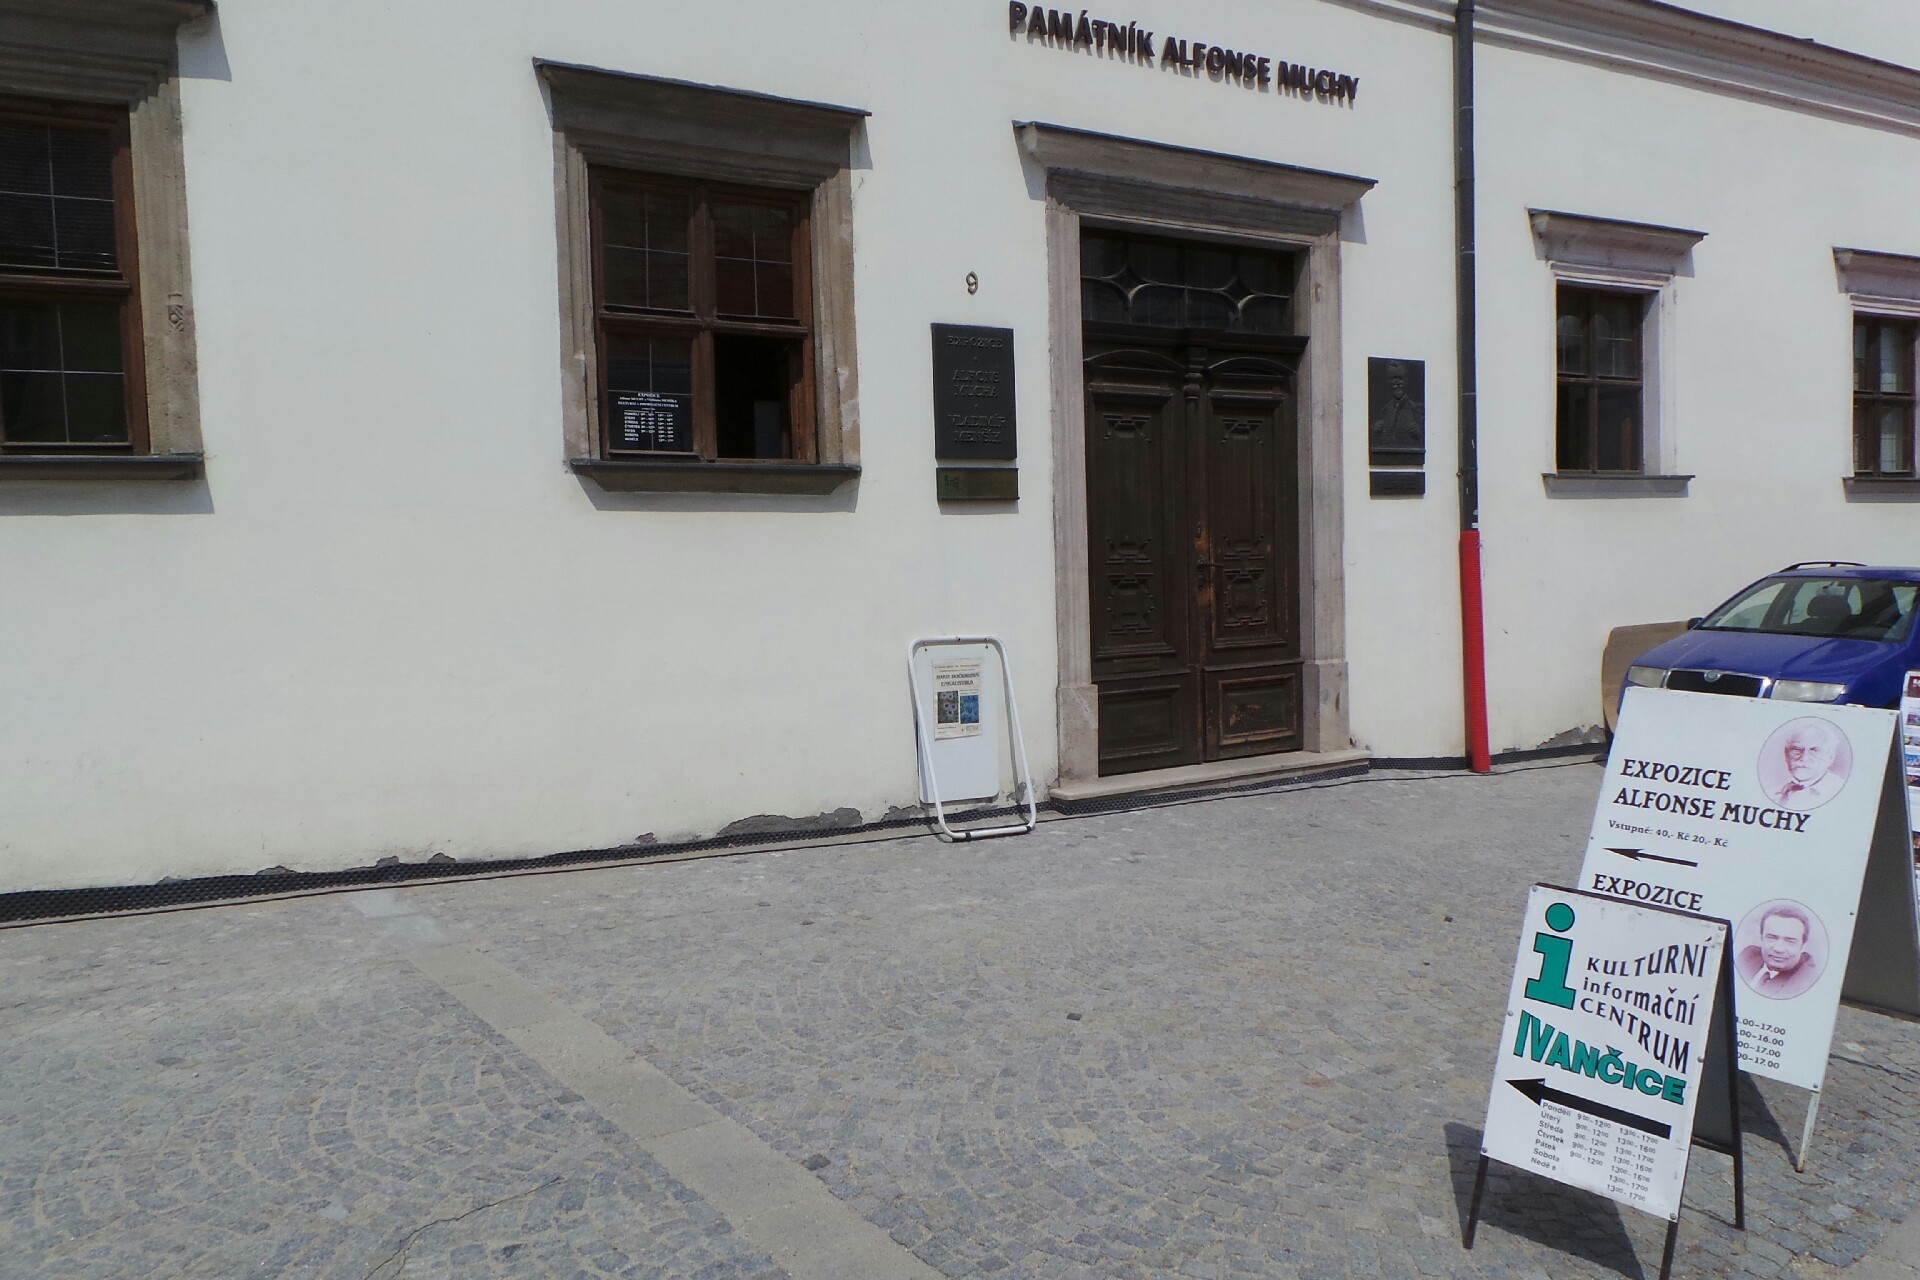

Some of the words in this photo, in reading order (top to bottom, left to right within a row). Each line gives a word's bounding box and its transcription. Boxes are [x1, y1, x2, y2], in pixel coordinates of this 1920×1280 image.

[1009, 1, 1155, 58] PAMÁTNÍK
[1161, 36, 1271, 84] ALFONSE
[1278, 61, 1360, 100] MUCHY
[965, 270, 979, 296] 9
[1620, 759, 1732, 790] EXPOZICE
[1613, 787, 1716, 819] ALFONSE
[1720, 802, 1811, 833] MUCHY
[1608, 820, 1653, 834] Vstupné:
[1677, 831, 1690, 841] Kč
[1713, 837, 1729, 848] Kč
[1592, 873, 1703, 911] EXPOZICE
[1587, 936, 1712, 978] KULTURNÍ
[1582, 977, 1699, 1026] informační
[1580, 998, 1690, 1075] CENTRUM
[1735, 1017, 1786, 1035] .00-17.00
[1513, 1009, 1687, 1105] IVANČICE
[1536, 1128, 1565, 1144] Čtvrtek
[1539, 1120, 1564, 1134] Středa
[1533, 1148, 1560, 1163] Sobota
[1535, 1138, 1557, 1152] Pátek
[1530, 1156, 1557, 1172] Neděe
